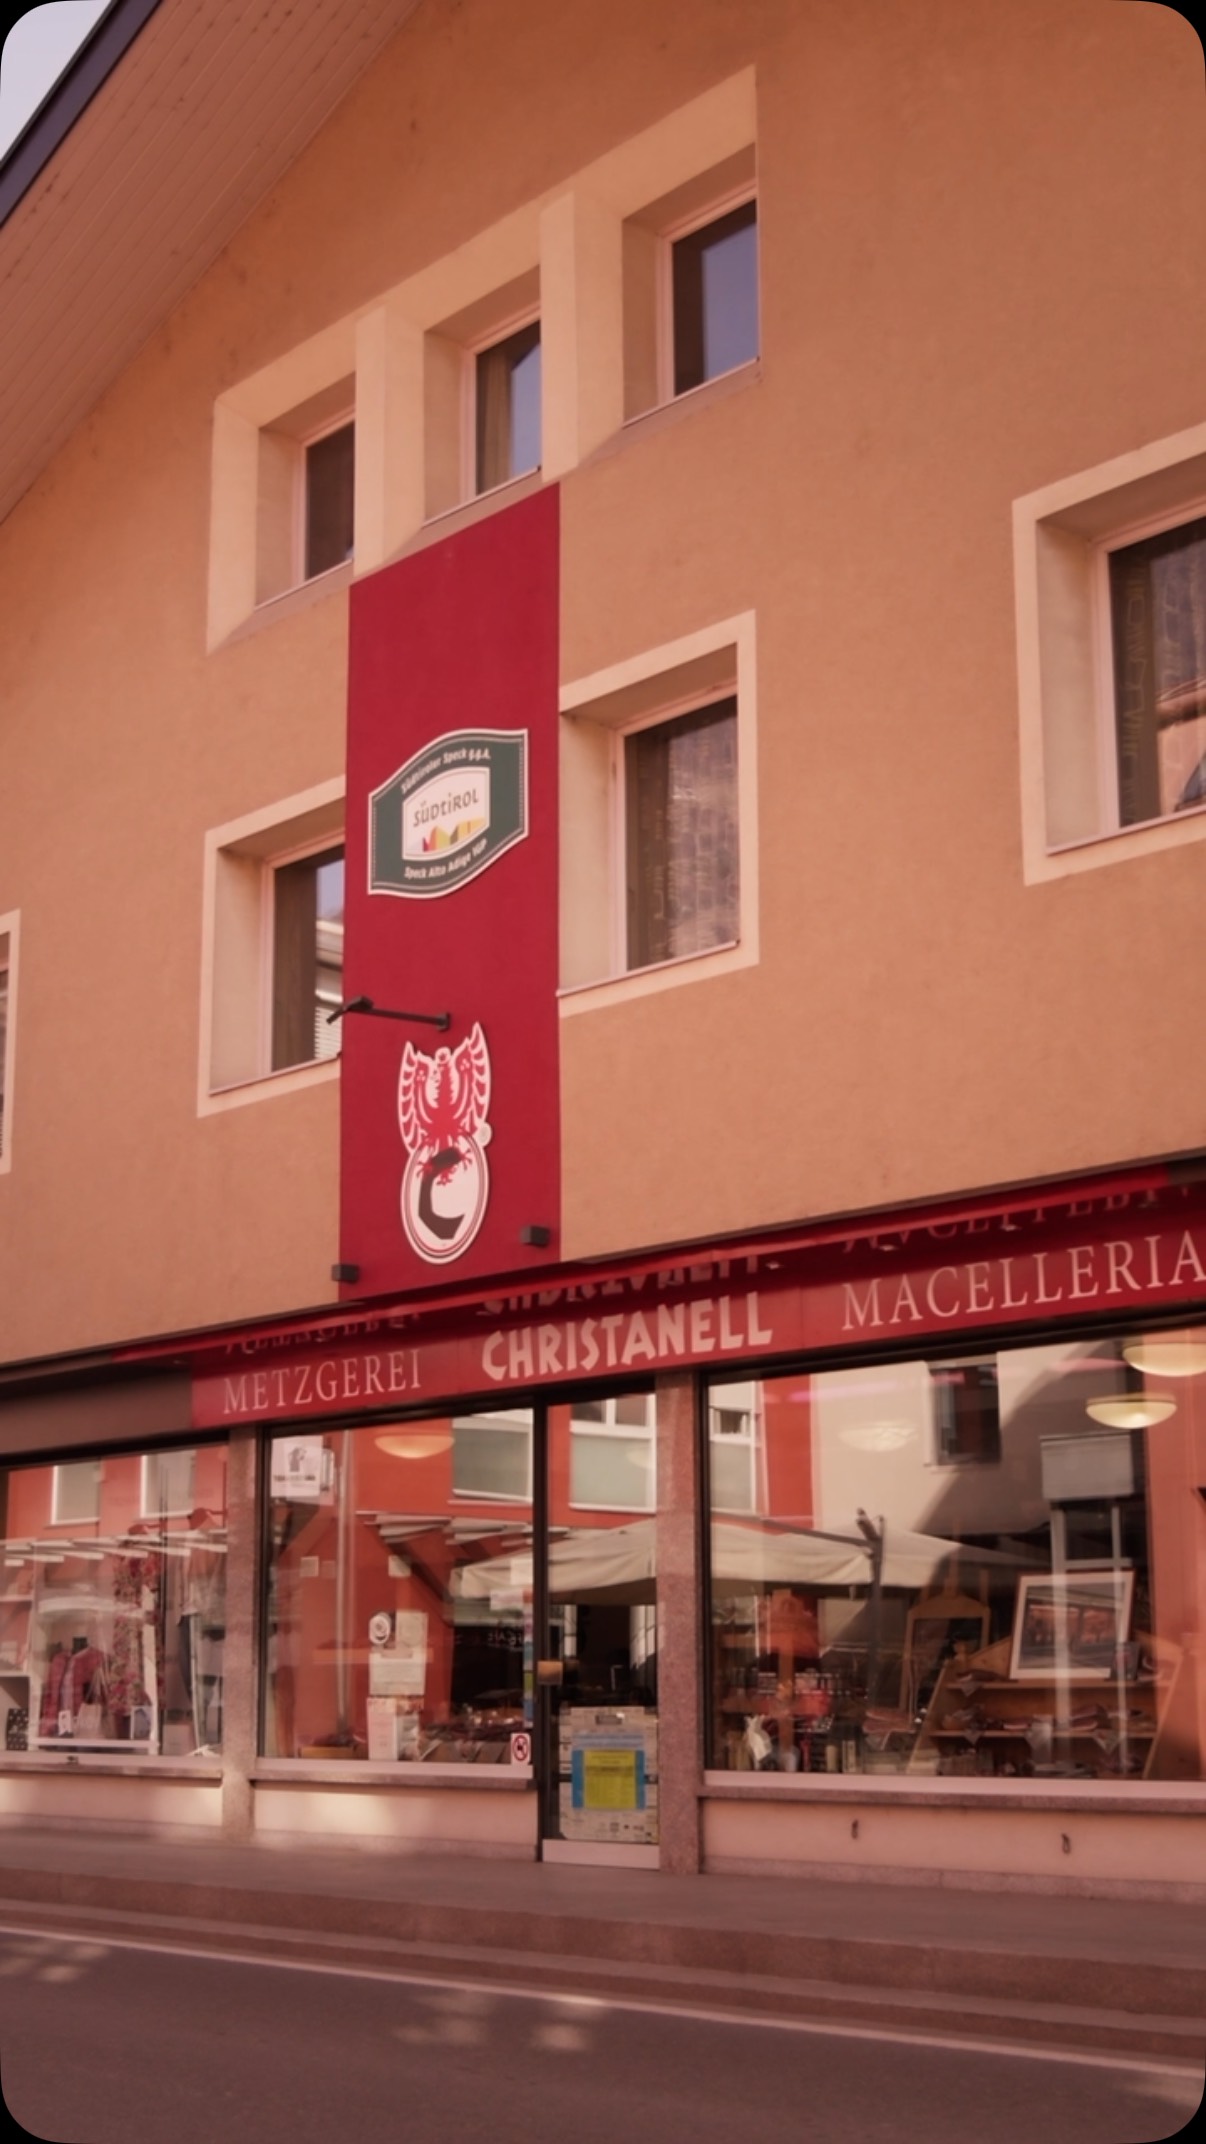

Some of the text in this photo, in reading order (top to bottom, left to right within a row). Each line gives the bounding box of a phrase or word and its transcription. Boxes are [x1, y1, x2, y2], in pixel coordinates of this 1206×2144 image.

[443, 747, 467, 764] Speck
[404, 865, 427, 880] Speck
[428, 865, 447, 878] Alto
[448, 852, 471, 872] Adige
[841, 1230, 1206, 1331] MACELLERIA
[482, 1291, 773, 1380] CHRISTANELL
[223, 1349, 422, 1415] METZGEREI
